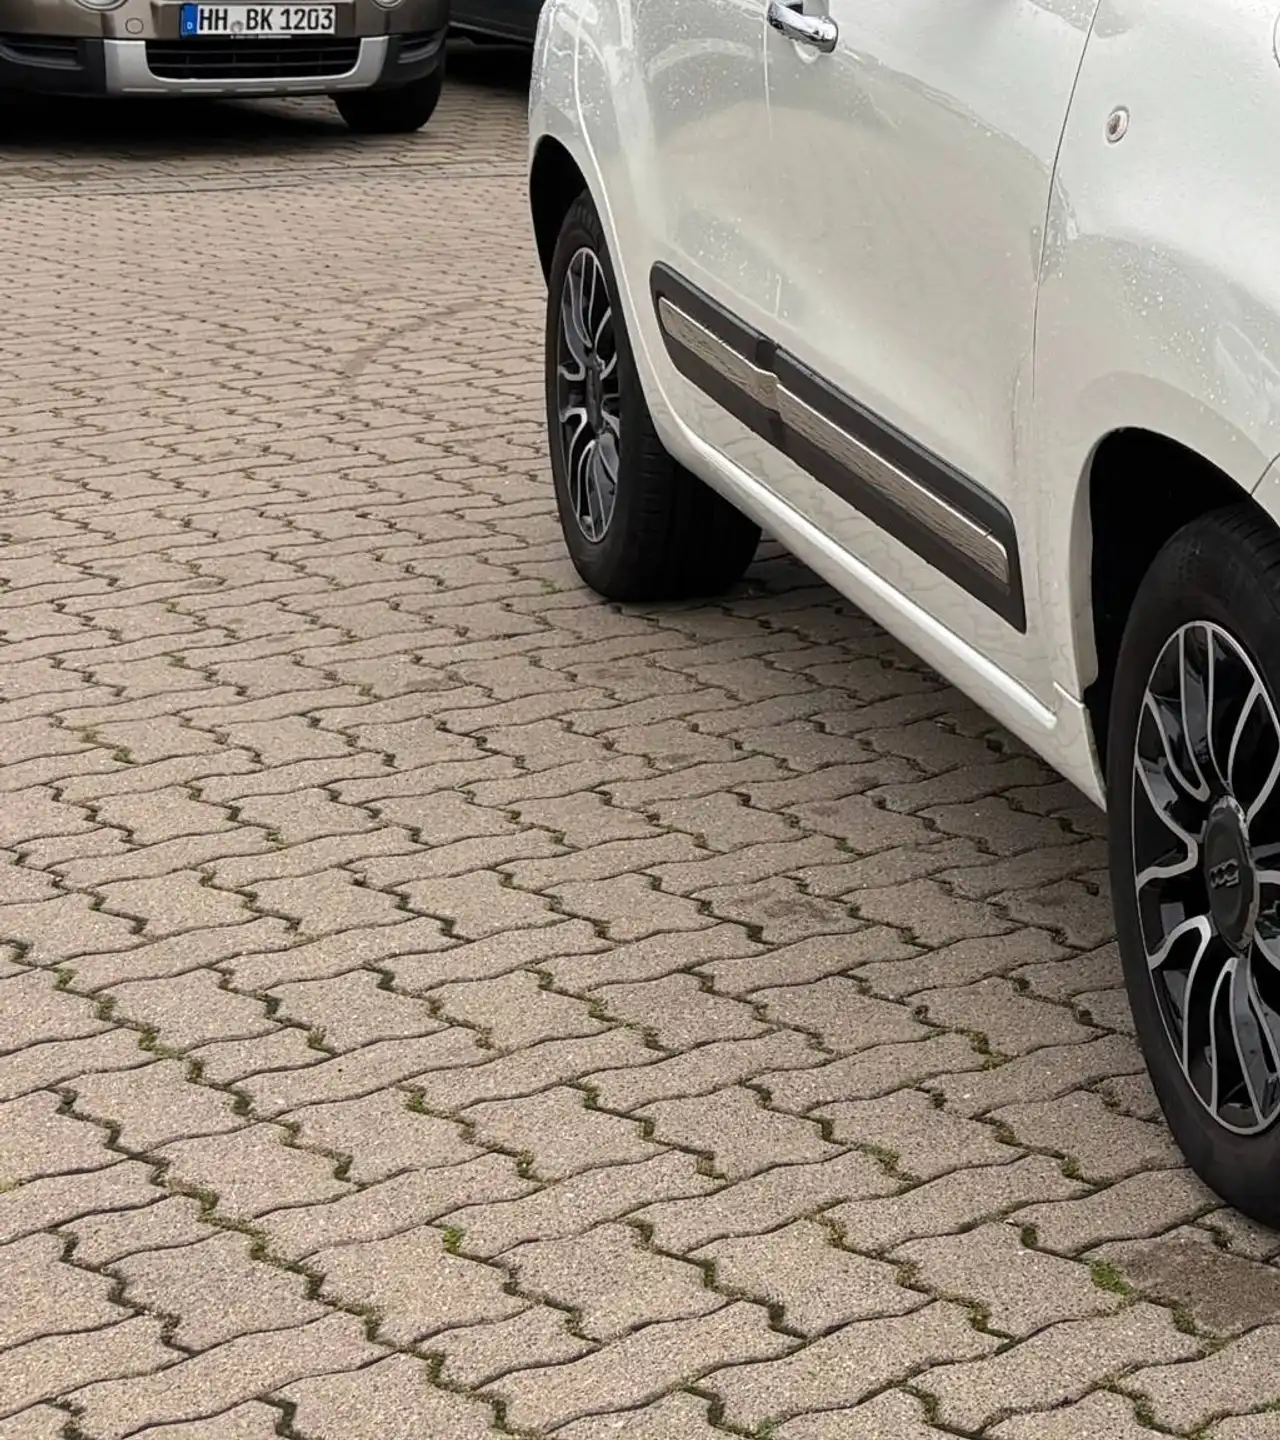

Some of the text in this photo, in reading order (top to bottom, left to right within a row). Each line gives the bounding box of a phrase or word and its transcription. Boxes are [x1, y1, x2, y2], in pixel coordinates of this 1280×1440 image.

[198, 8, 228, 32] HH
[245, 8, 274, 32] BK
[279, 8, 334, 32] 1203
